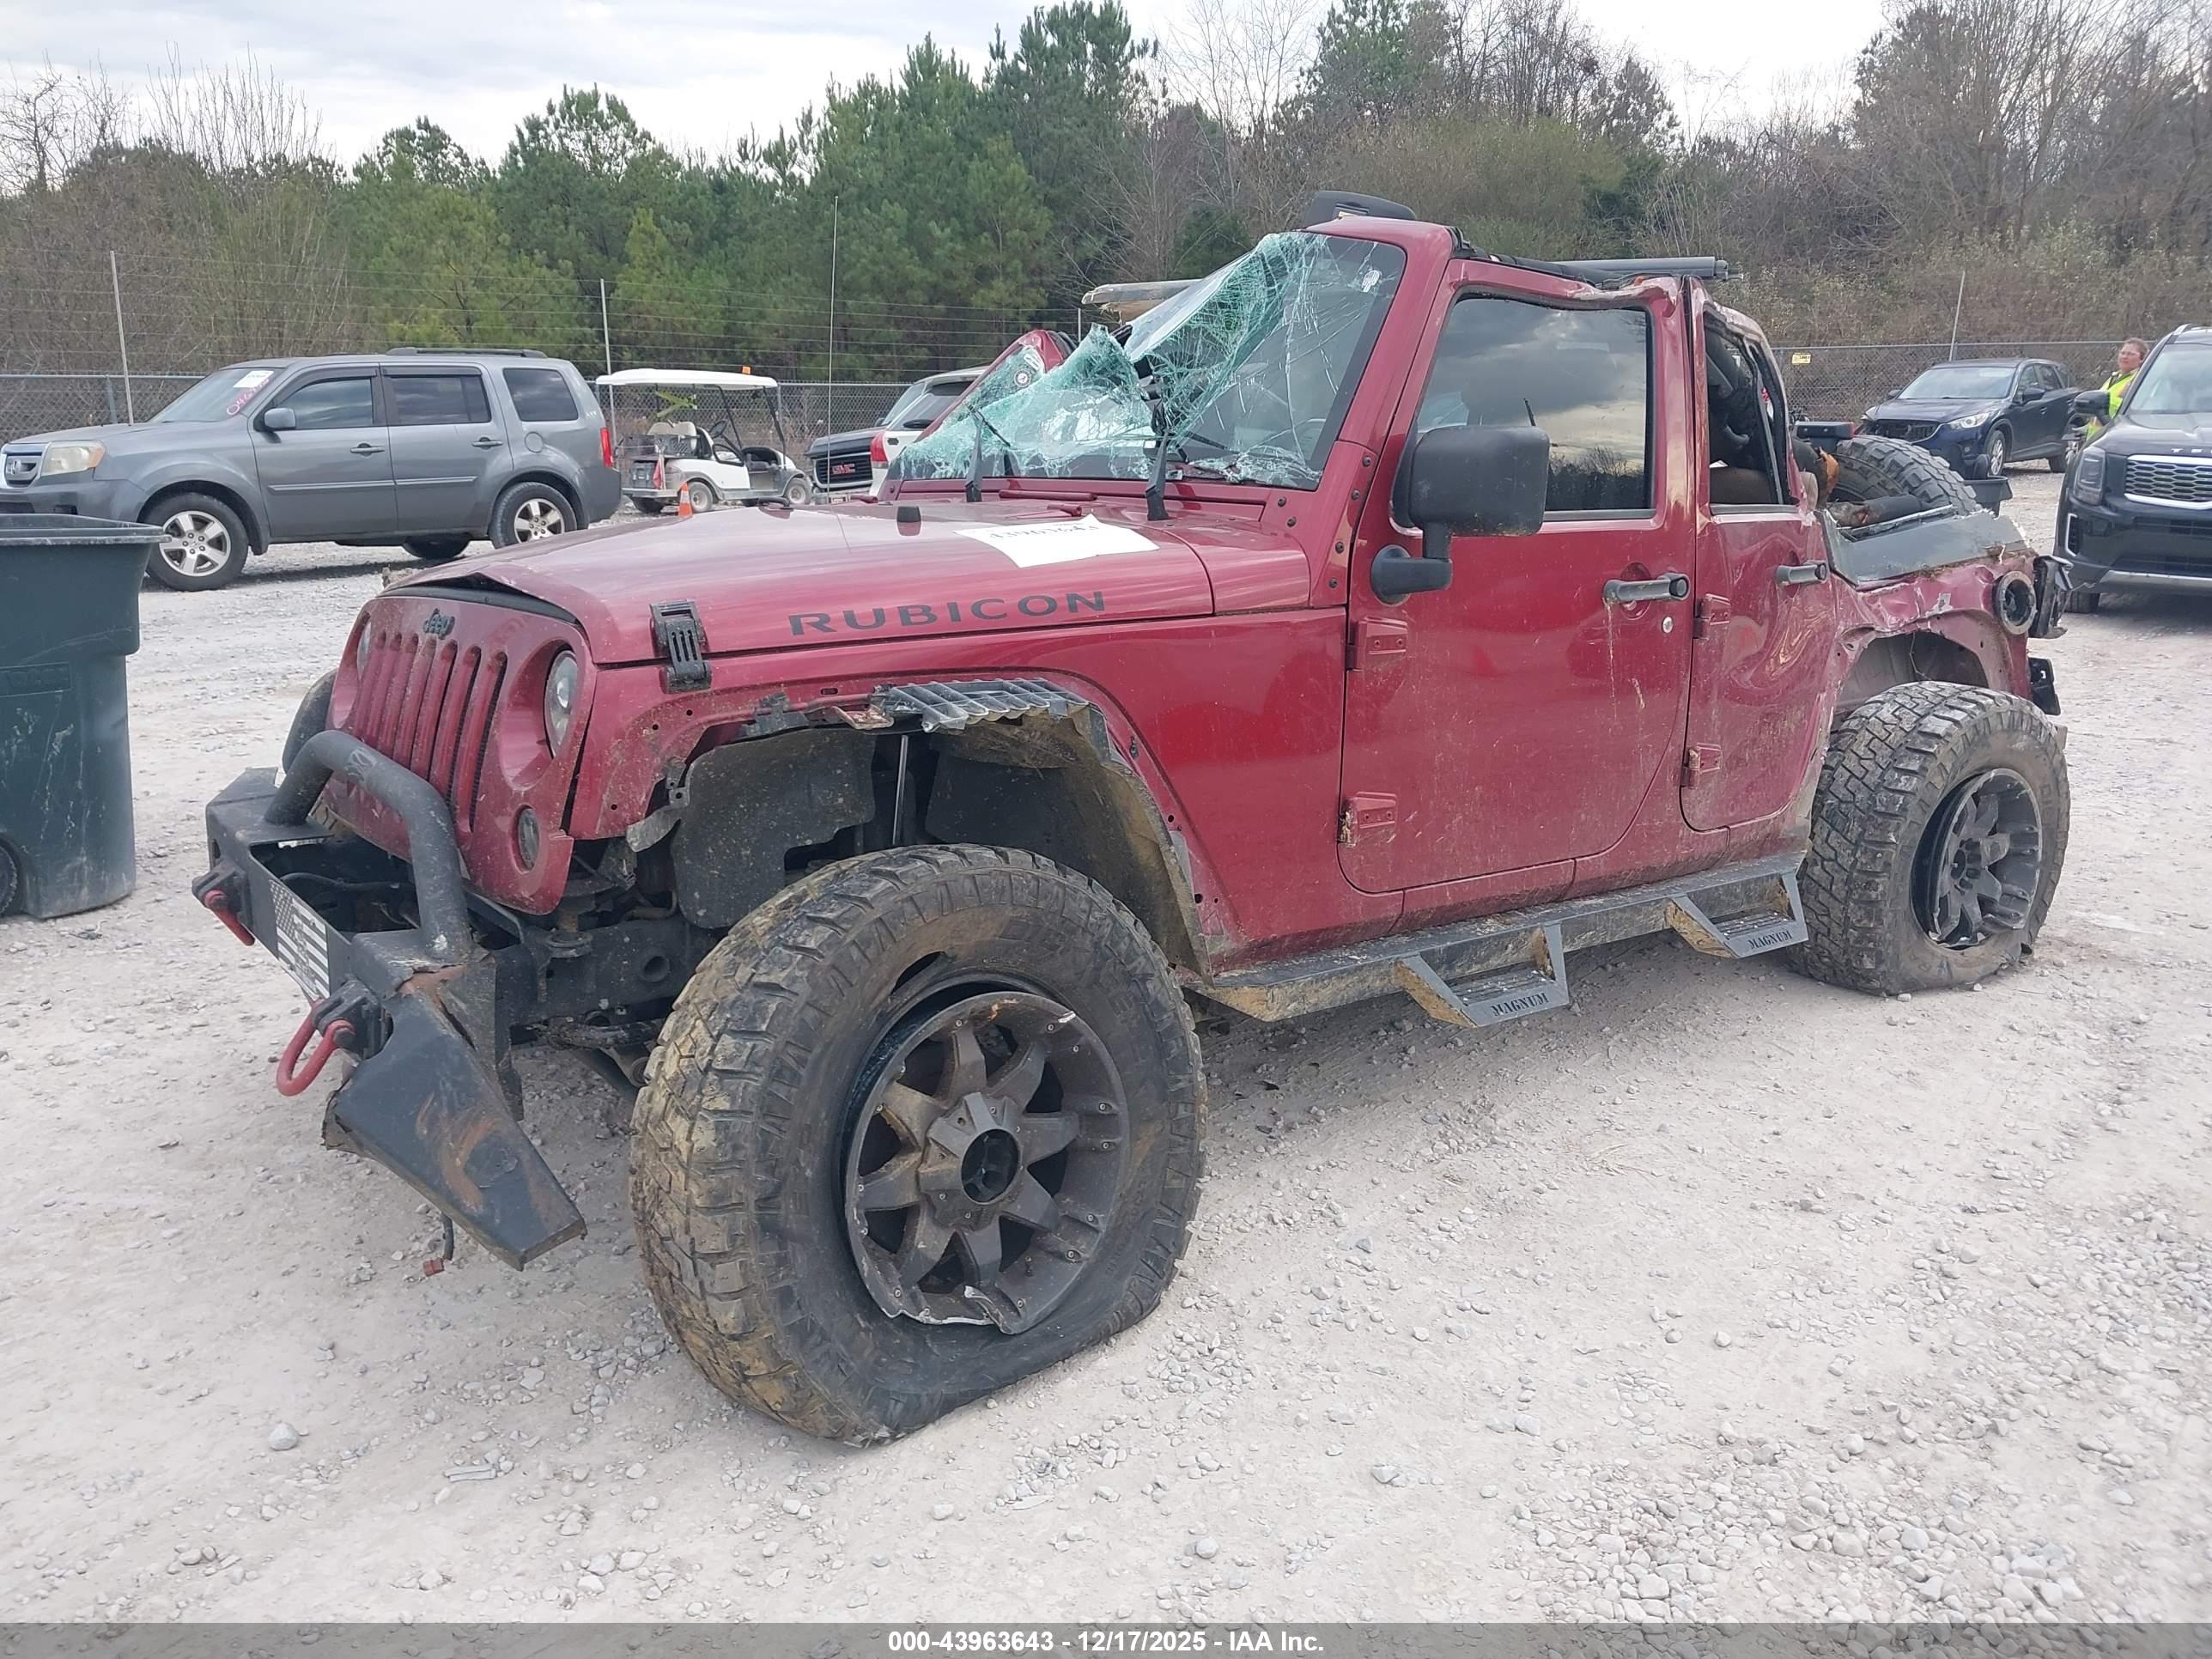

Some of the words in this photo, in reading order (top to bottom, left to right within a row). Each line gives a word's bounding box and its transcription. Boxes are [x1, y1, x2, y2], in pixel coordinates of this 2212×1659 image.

[831, 463, 856, 474] GMC
[788, 591, 1104, 635] RUBICON
[1747, 929, 1793, 950] MAGNUM
[1491, 991, 1549, 1018] MAGNUM
